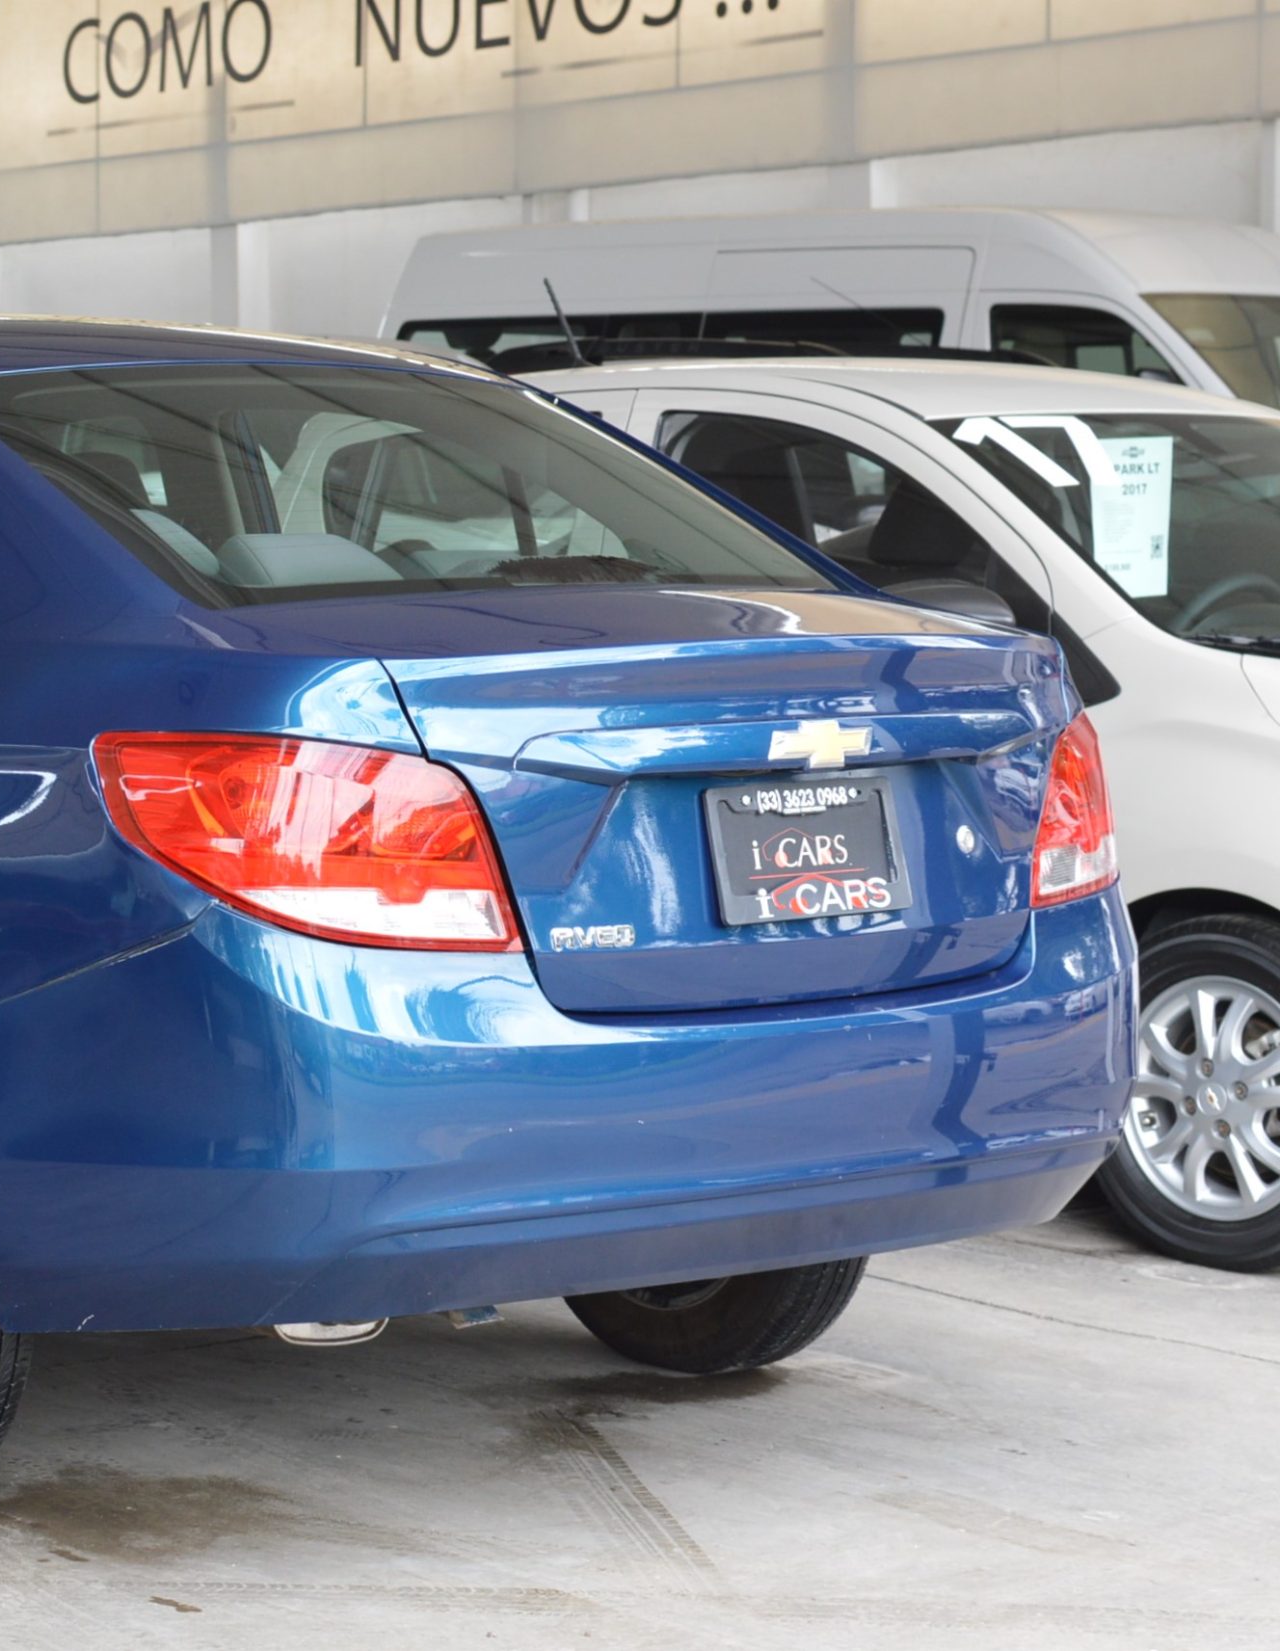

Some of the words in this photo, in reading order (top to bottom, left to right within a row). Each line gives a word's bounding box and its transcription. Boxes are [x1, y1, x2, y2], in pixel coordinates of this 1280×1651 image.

[64, 0, 272, 104] COMO
[952, 415, 1120, 487] 17
[1113, 463, 1145, 475] PARK
[1147, 462, 1160, 474] LT
[1122, 483, 1147, 496] 2017
[757, 789, 782, 814] (33)
[783, 788, 815, 808] 3623
[816, 786, 848, 805] 0968
[752, 840, 762, 870] i
[778, 834, 848, 868] CARS
[755, 888, 774, 918] i
[795, 877, 891, 915] CARS
